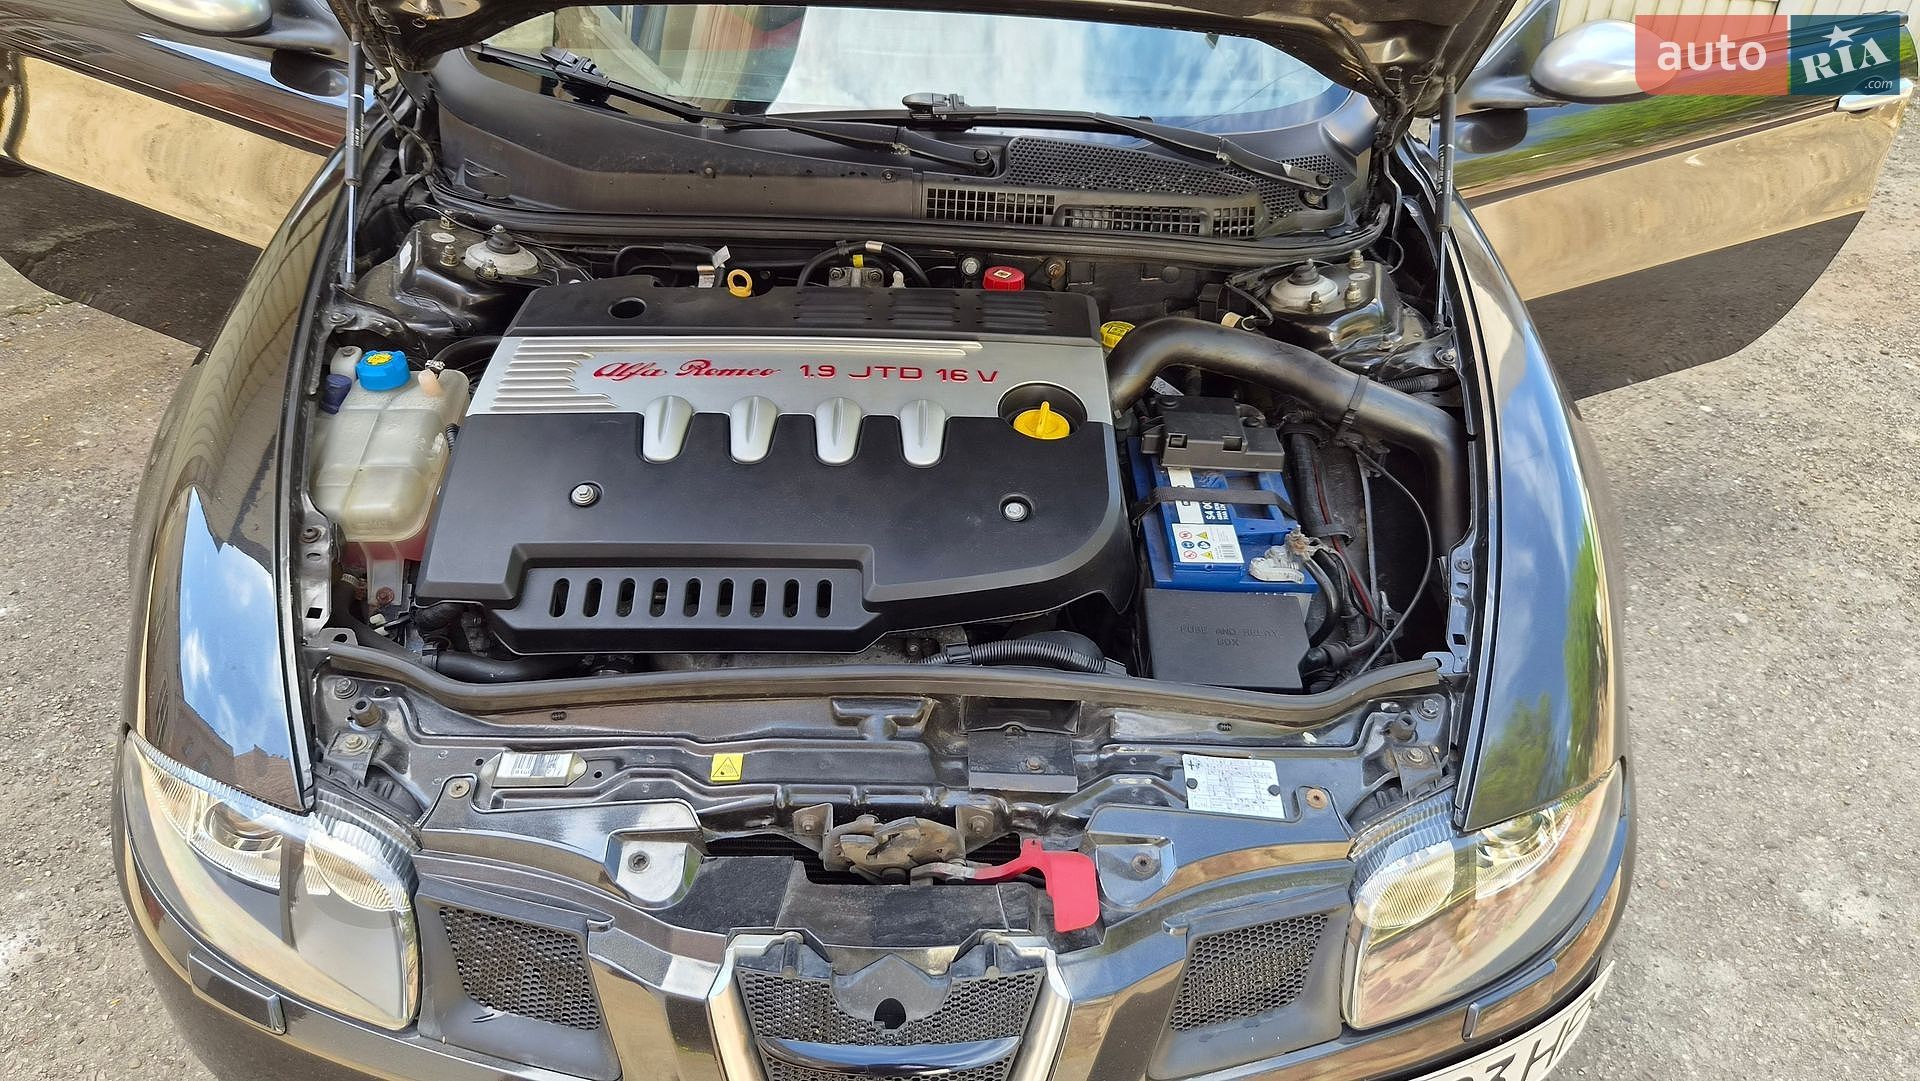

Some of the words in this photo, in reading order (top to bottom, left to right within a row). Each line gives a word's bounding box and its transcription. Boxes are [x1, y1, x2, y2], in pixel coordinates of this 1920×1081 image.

[592, 361, 668, 382] Alfa
[674, 358, 782, 378] Romeo
[799, 364, 838, 379] 1.9
[847, 365, 924, 382] JTD
[935, 368, 970, 384] 16
[976, 370, 1000, 385] V
